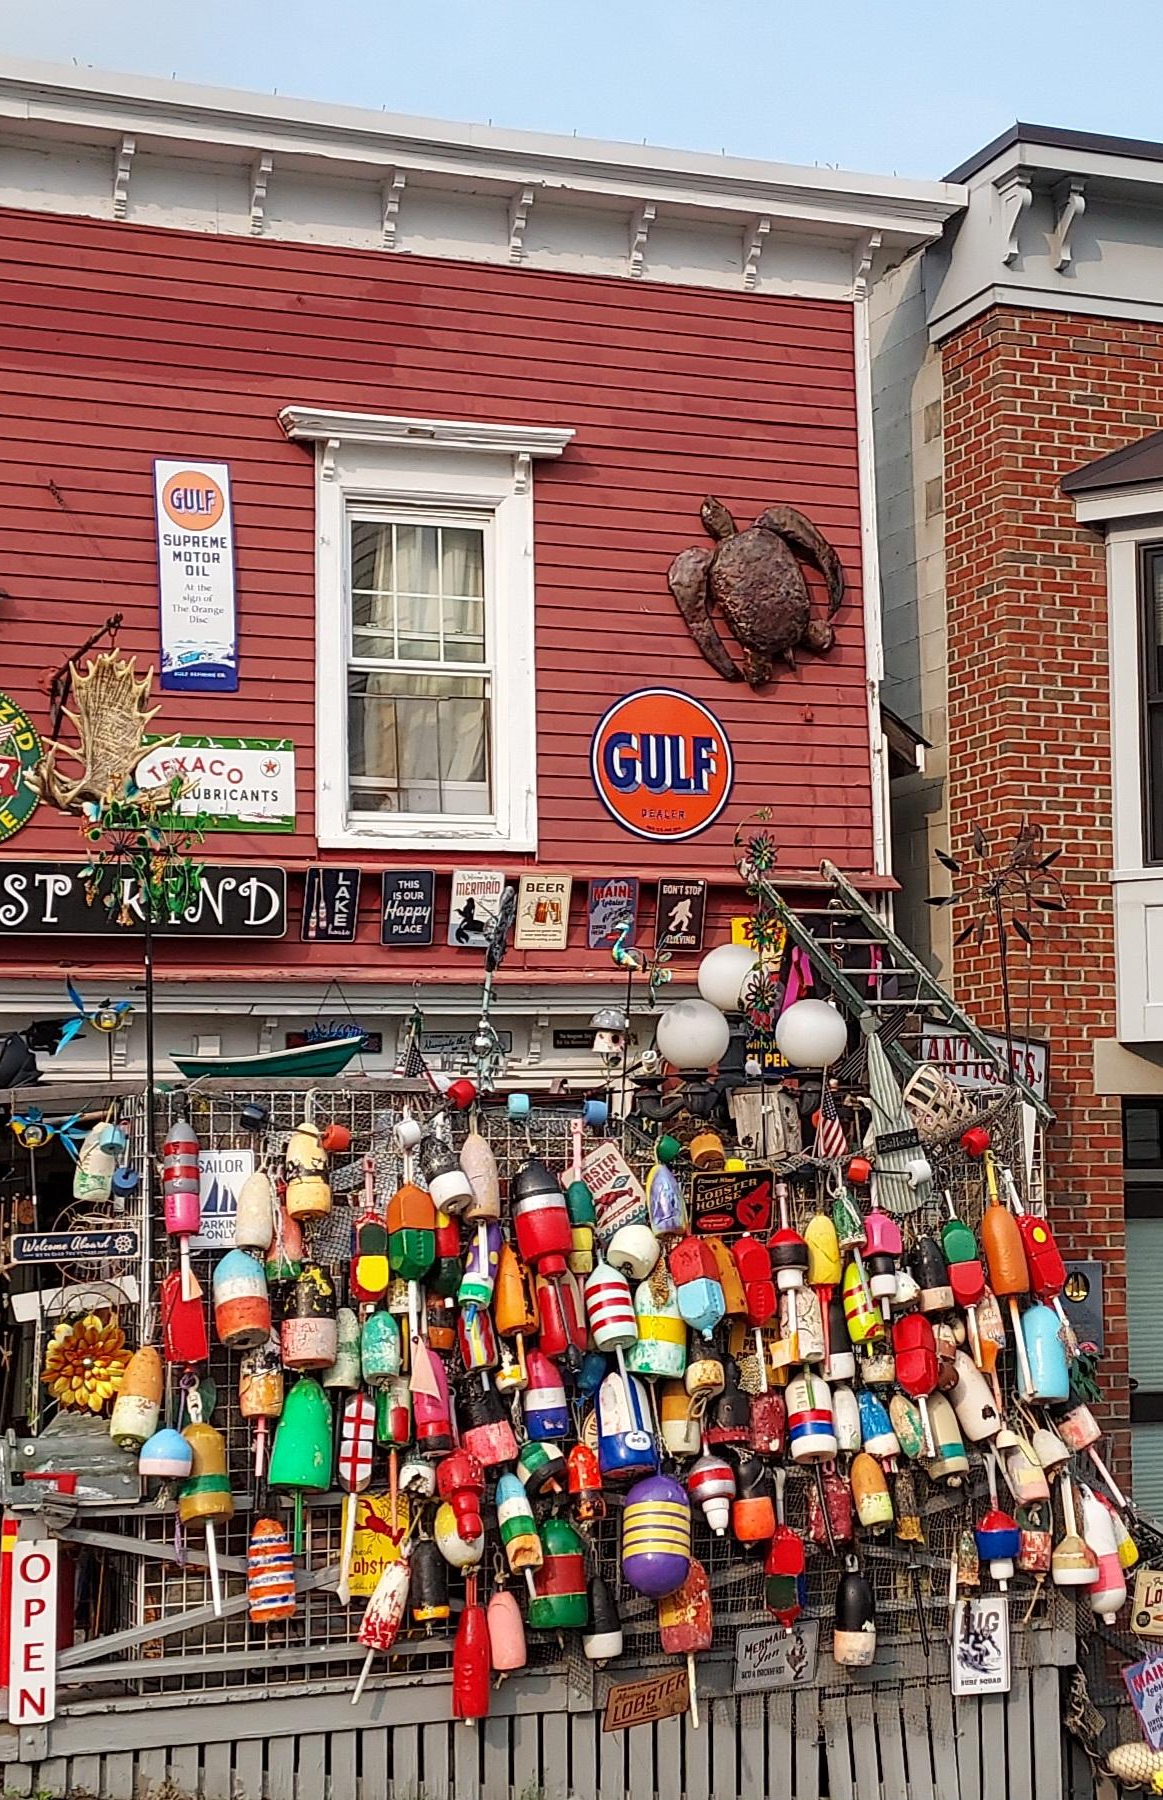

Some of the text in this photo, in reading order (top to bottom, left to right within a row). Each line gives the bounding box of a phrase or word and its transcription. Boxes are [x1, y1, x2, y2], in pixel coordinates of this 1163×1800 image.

[170, 487, 216, 515] GULF
[163, 533, 227, 549] SUPREME
[173, 550, 221, 564] MOTOR
[185, 563, 210, 577] OIL
[184, 583, 212, 592] At the
[182, 593, 213, 604] sign of
[172, 603, 224, 615] The Orange
[189, 614, 208, 625] Disc
[147, 756, 243, 784] TEXACO
[603, 731, 718, 795] GULF
[185, 787, 278, 802] LUBRICANTS
[641, 809, 685, 820] DEALER
[397, 880, 420, 889] THIS
[456, 881, 501, 897] MERMAID
[526, 882, 565, 893] BEER
[663, 884, 702, 895] DON'T STOP
[334, 872, 351, 927] LAKE
[393, 891, 424, 900] IS OUR
[592, 885, 633, 900] MAINE
[384, 900, 431, 924] Happy
[327, 924, 351, 935] house
[392, 925, 422, 934] PLACE
[878, 1135, 917, 1150] Believe
[198, 1158, 243, 1173] SAILOR
[696, 1178, 757, 1202] LOBSTER
[696, 1190, 741, 1211] HOUSE
[207, 1229, 237, 1240] ONLY
[21, 1235, 112, 1253] Welcome Aboard
[960, 1611, 1000, 1636] BIG
[19, 1553, 52, 1718] OPEN
[744, 1630, 787, 1659] MERMAID
[753, 1649, 780, 1674] Inn
[613, 1672, 687, 1722] LOBSTER
